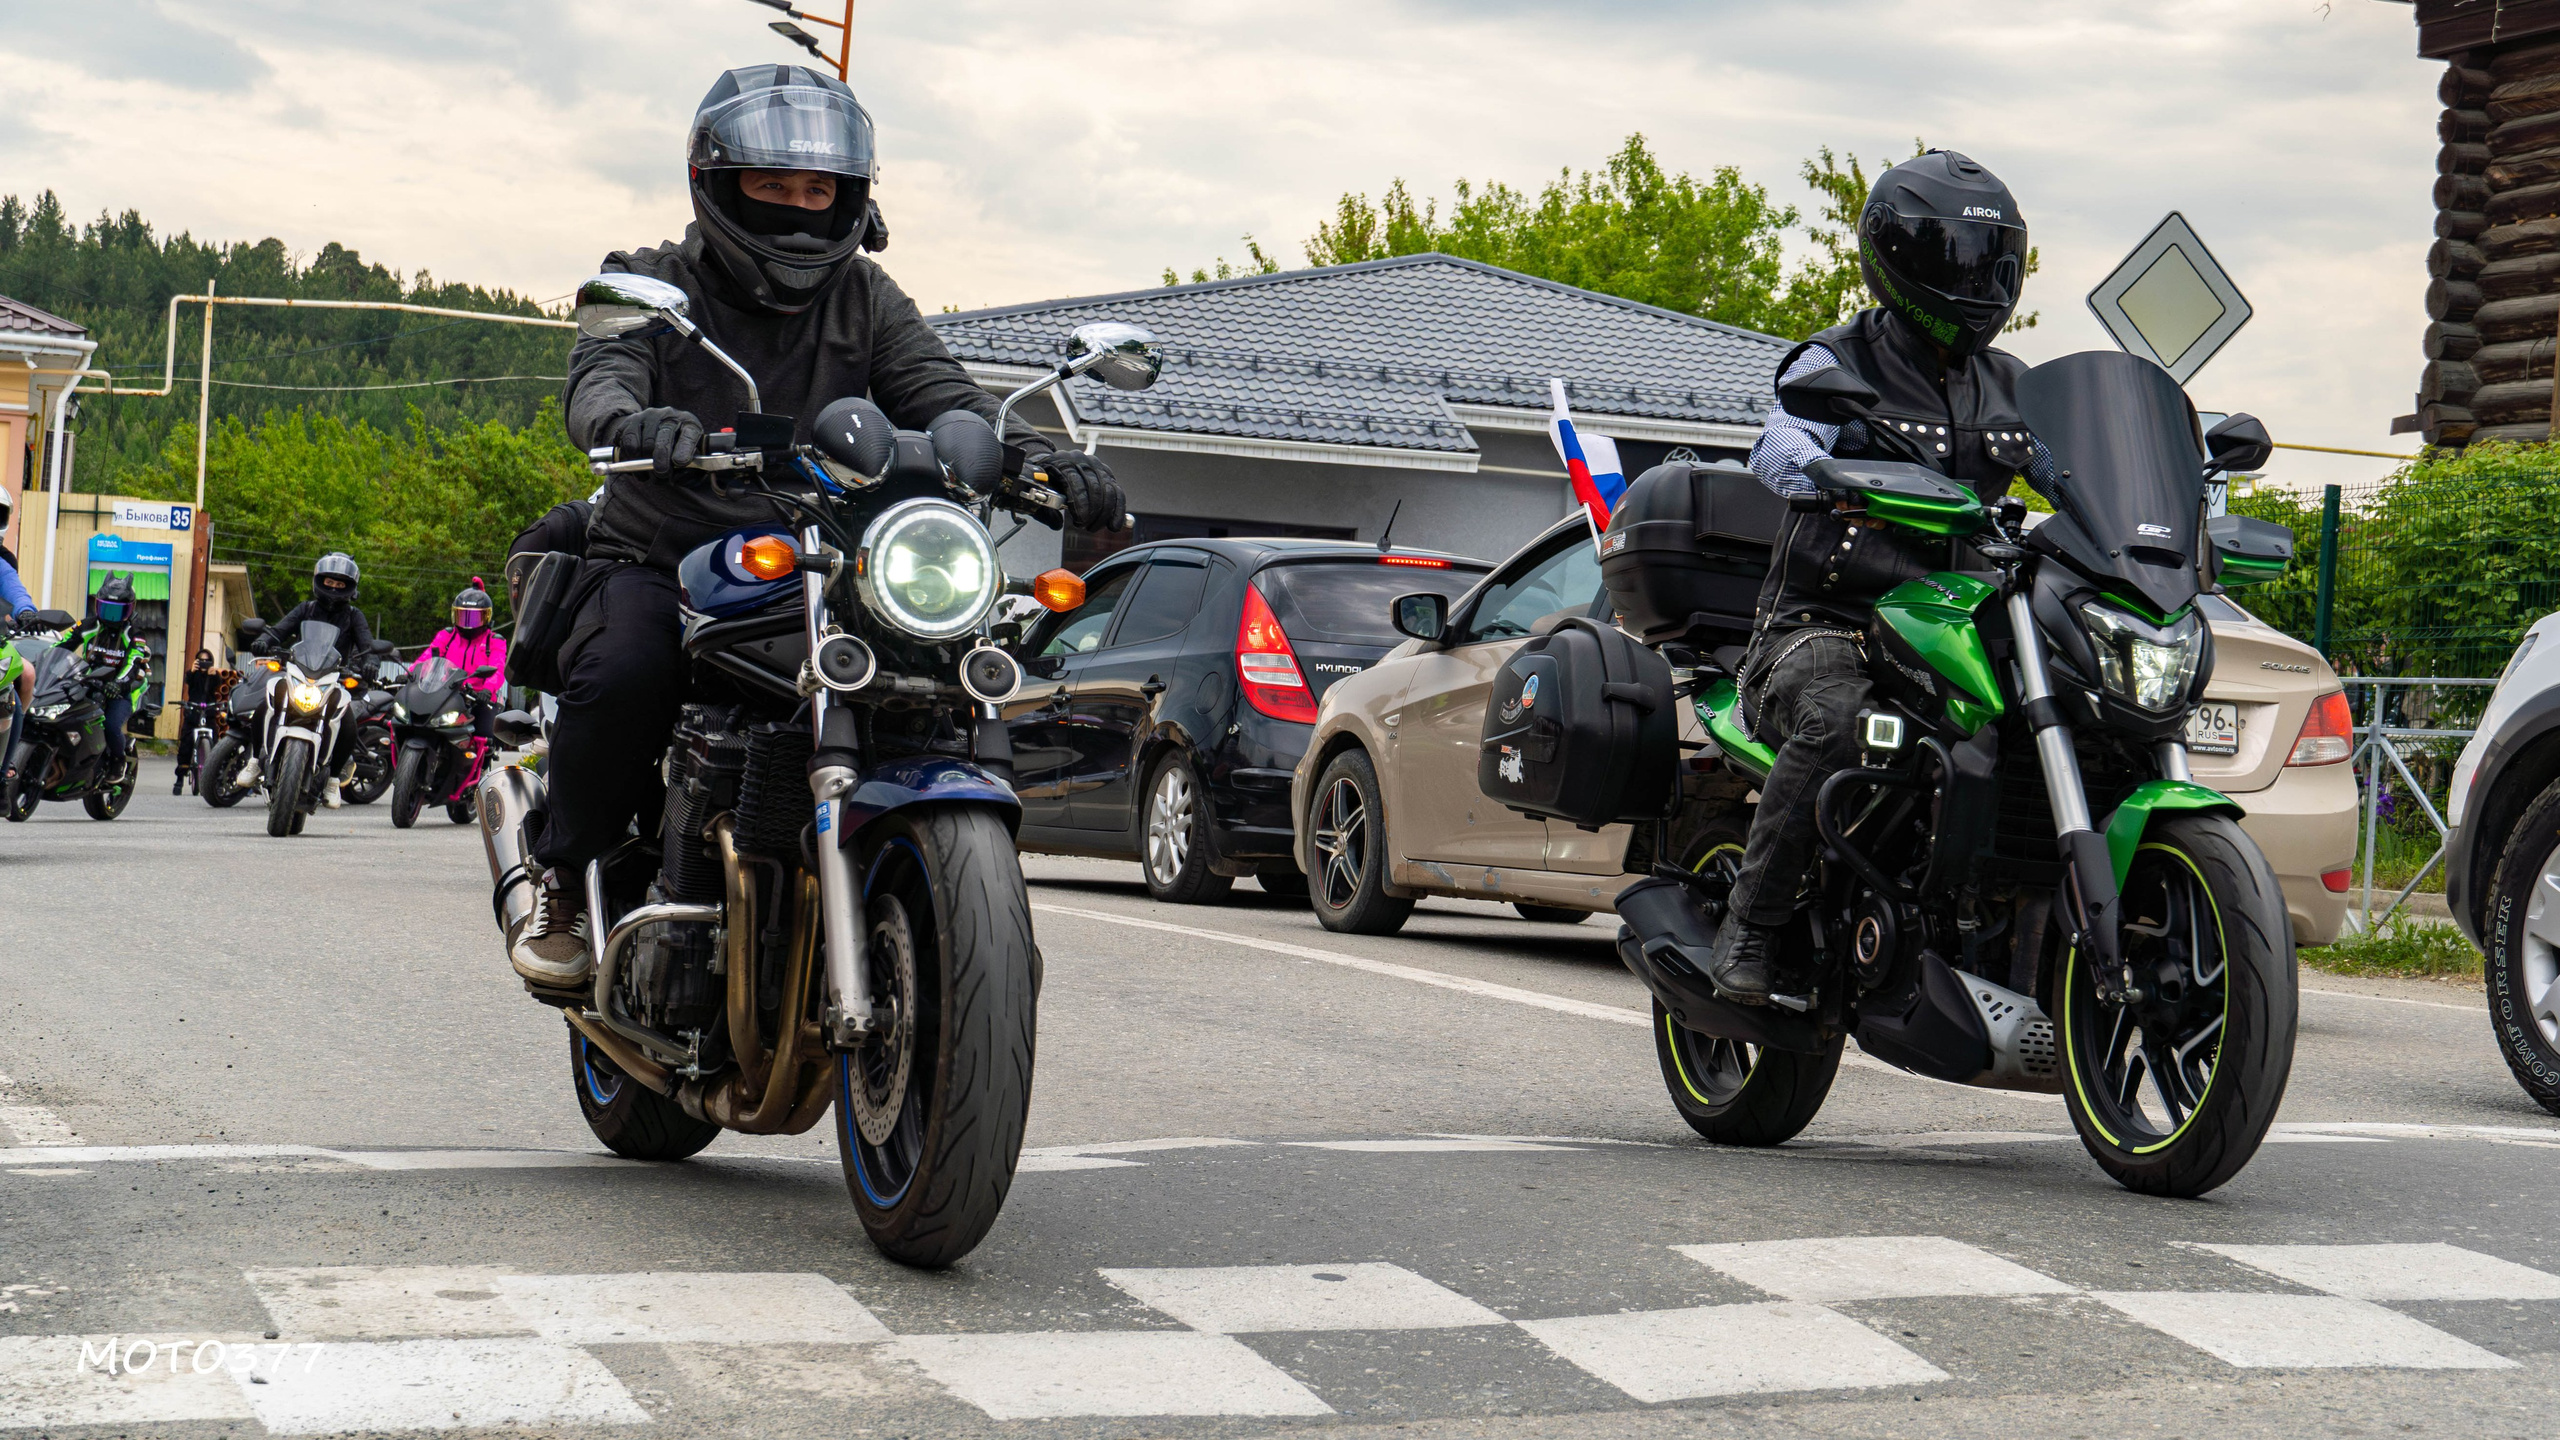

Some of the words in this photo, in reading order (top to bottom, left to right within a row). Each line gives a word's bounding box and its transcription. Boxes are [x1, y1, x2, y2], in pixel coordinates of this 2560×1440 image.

[788, 139, 835, 155] SMK
[1962, 206, 2001, 220] AIROH
[114, 513, 125, 522] ул.
[126, 508, 169, 524] Быкова
[172, 509, 191, 528] 35
[136, 554, 168, 563] Профлист
[1315, 663, 1362, 674] HYUNDAI
[2260, 661, 2311, 675] SOLARIS
[2200, 706, 2226, 731] 96
[2198, 731, 2218, 740] RUS
[2192, 744, 2235, 754] www.avtomir.ru
[2495, 895, 2560, 1086] COMFORSER
